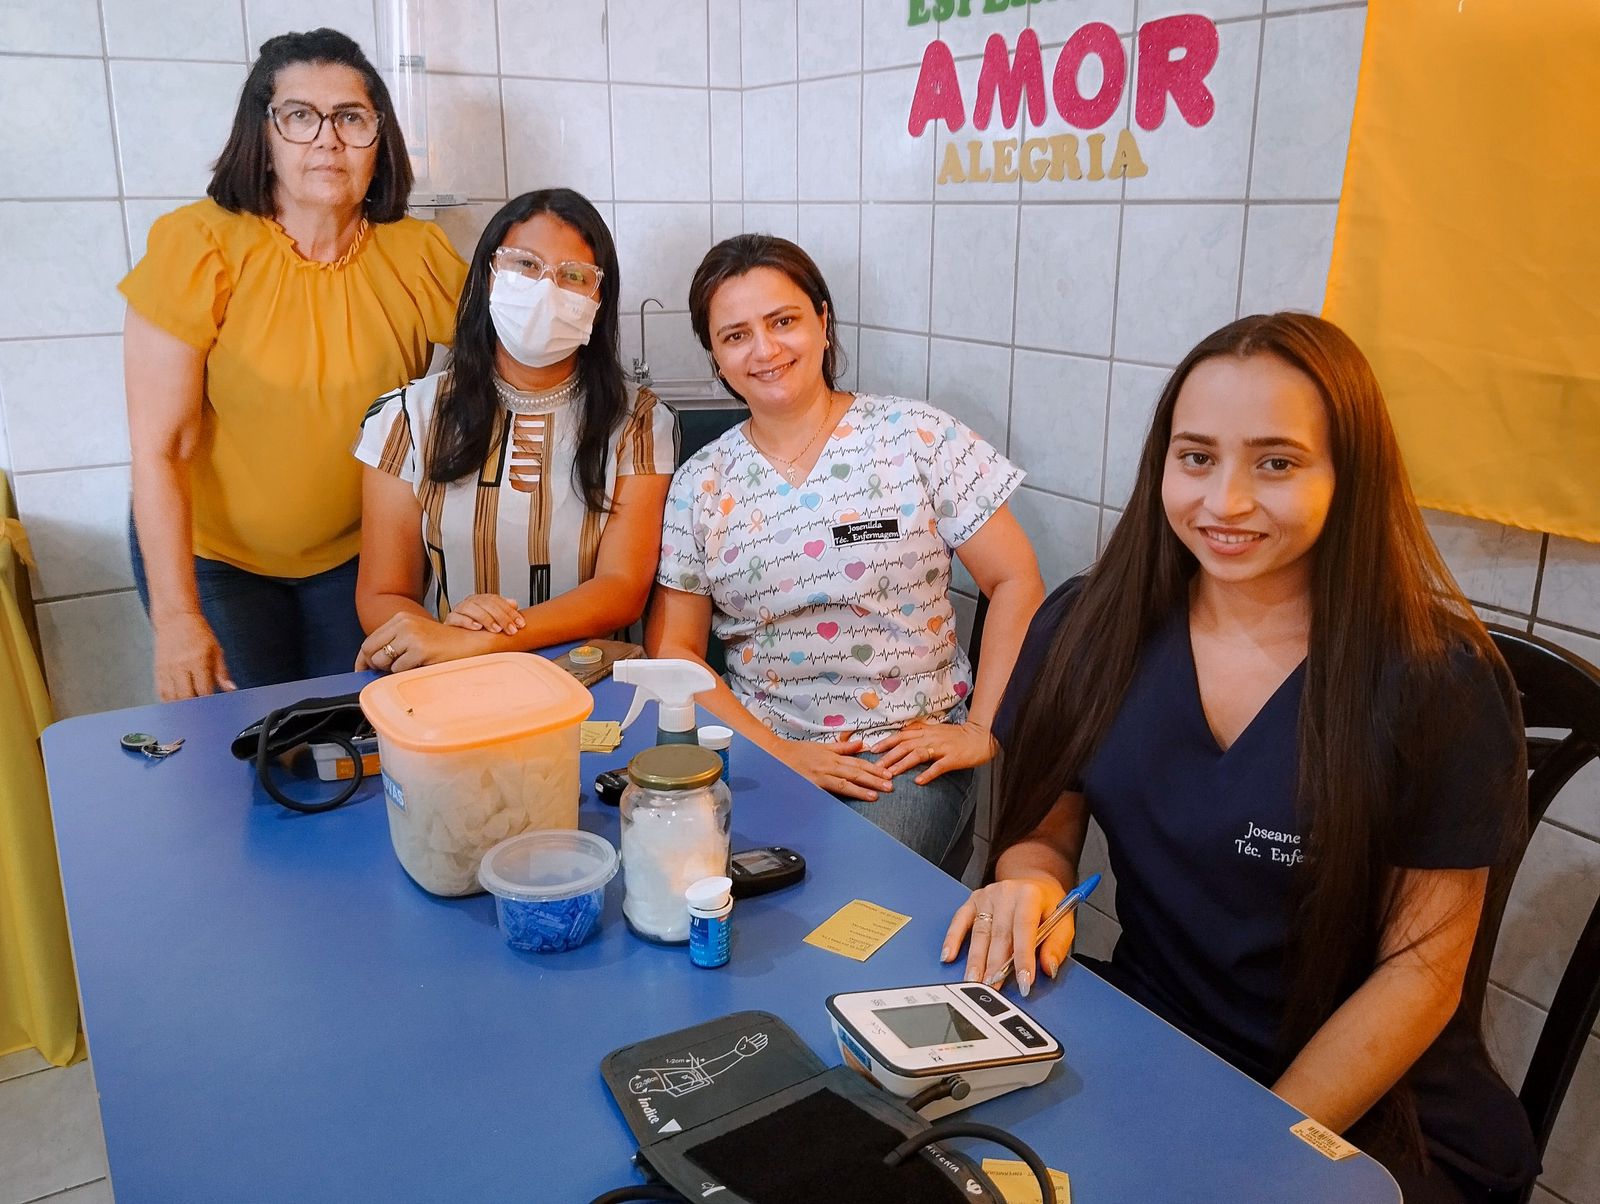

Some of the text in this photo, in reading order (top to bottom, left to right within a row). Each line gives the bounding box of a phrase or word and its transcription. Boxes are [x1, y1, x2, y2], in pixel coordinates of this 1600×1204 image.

[907, 13, 1220, 138] AMOR
[937, 128, 1149, 185] ALEGRIA
[848, 520, 883, 534] Josenilda
[852, 531, 899, 541] Enfermagem
[1244, 821, 1301, 844] Joseane
[1235, 839, 1304, 867] Téc. Enfe
